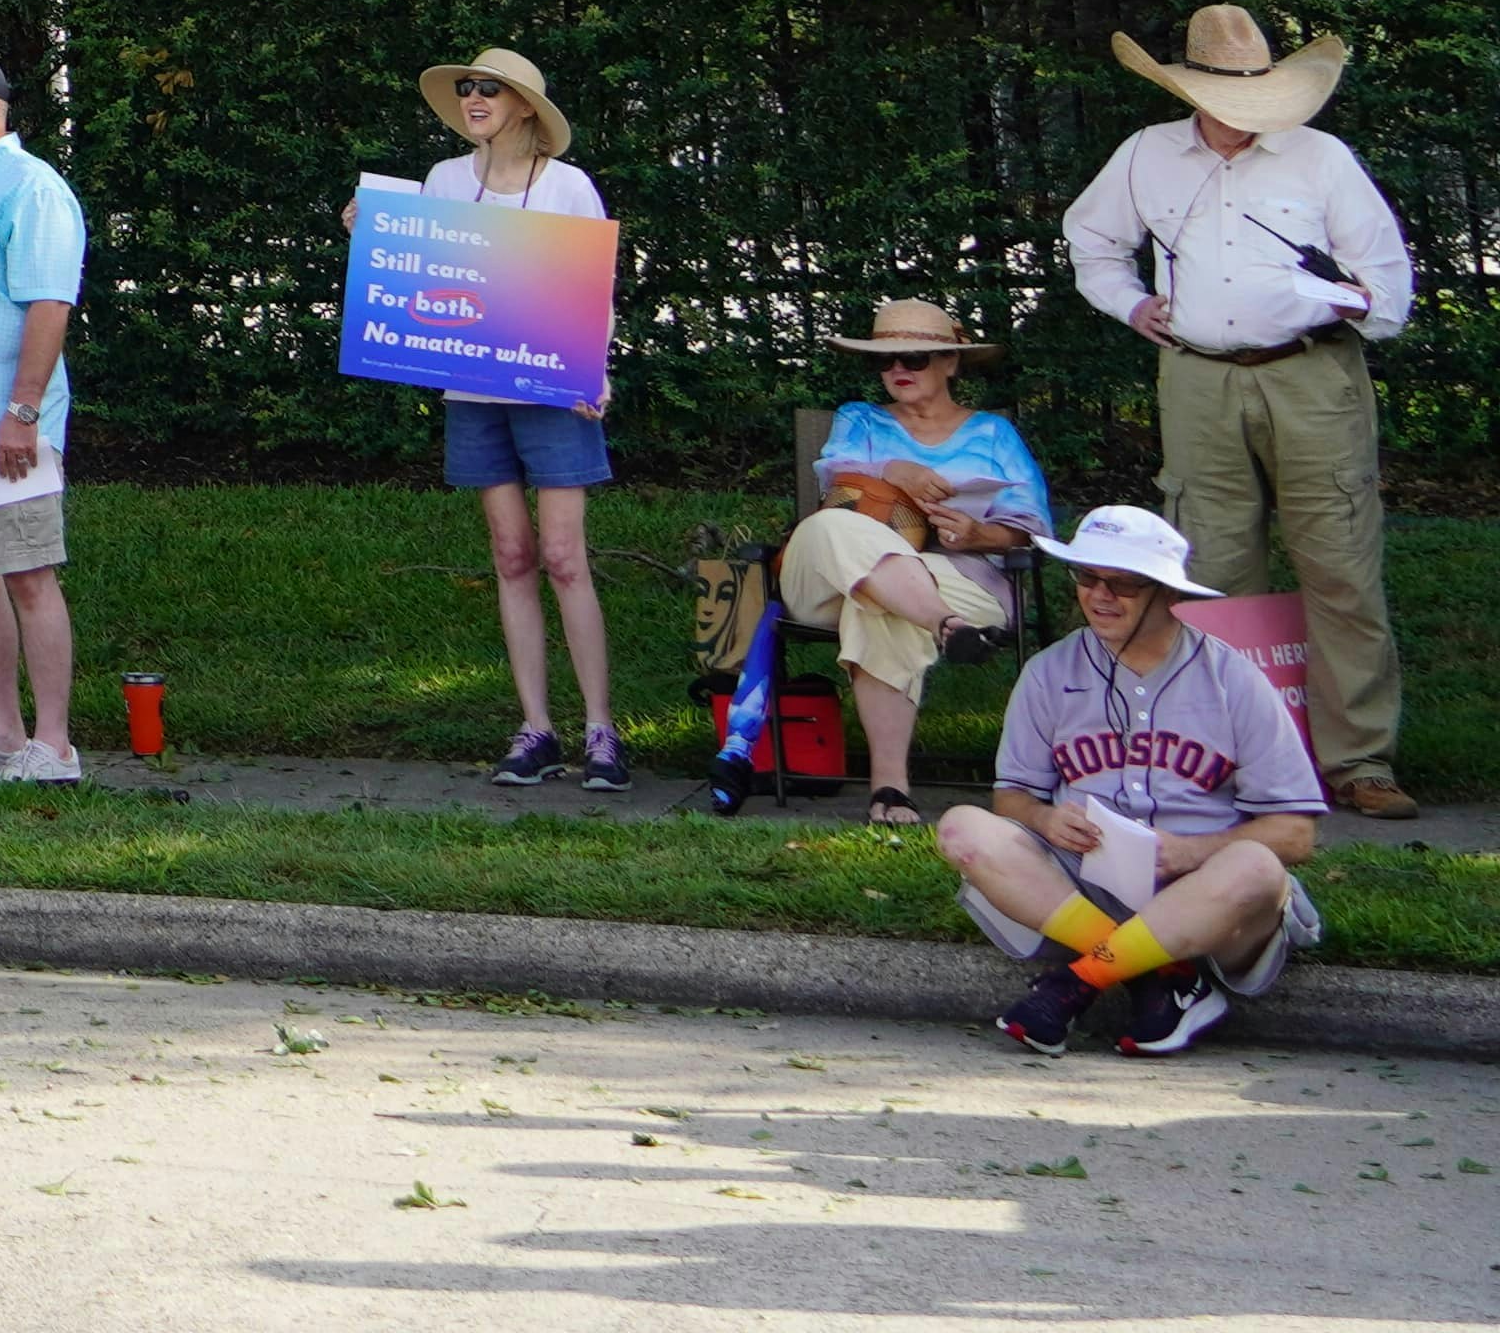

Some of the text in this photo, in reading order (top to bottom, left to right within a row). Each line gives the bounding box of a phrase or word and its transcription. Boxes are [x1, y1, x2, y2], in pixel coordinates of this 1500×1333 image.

[374, 212, 491, 247] Still here.
[370, 248, 486, 283] Still care.
[367, 284, 484, 320] For both.
[363, 321, 399, 346] No
[404, 333, 491, 359] matter
[496, 343, 566, 371] what.
[1270, 642, 1308, 666] HER
[1051, 730, 1236, 793] HOUSTON
